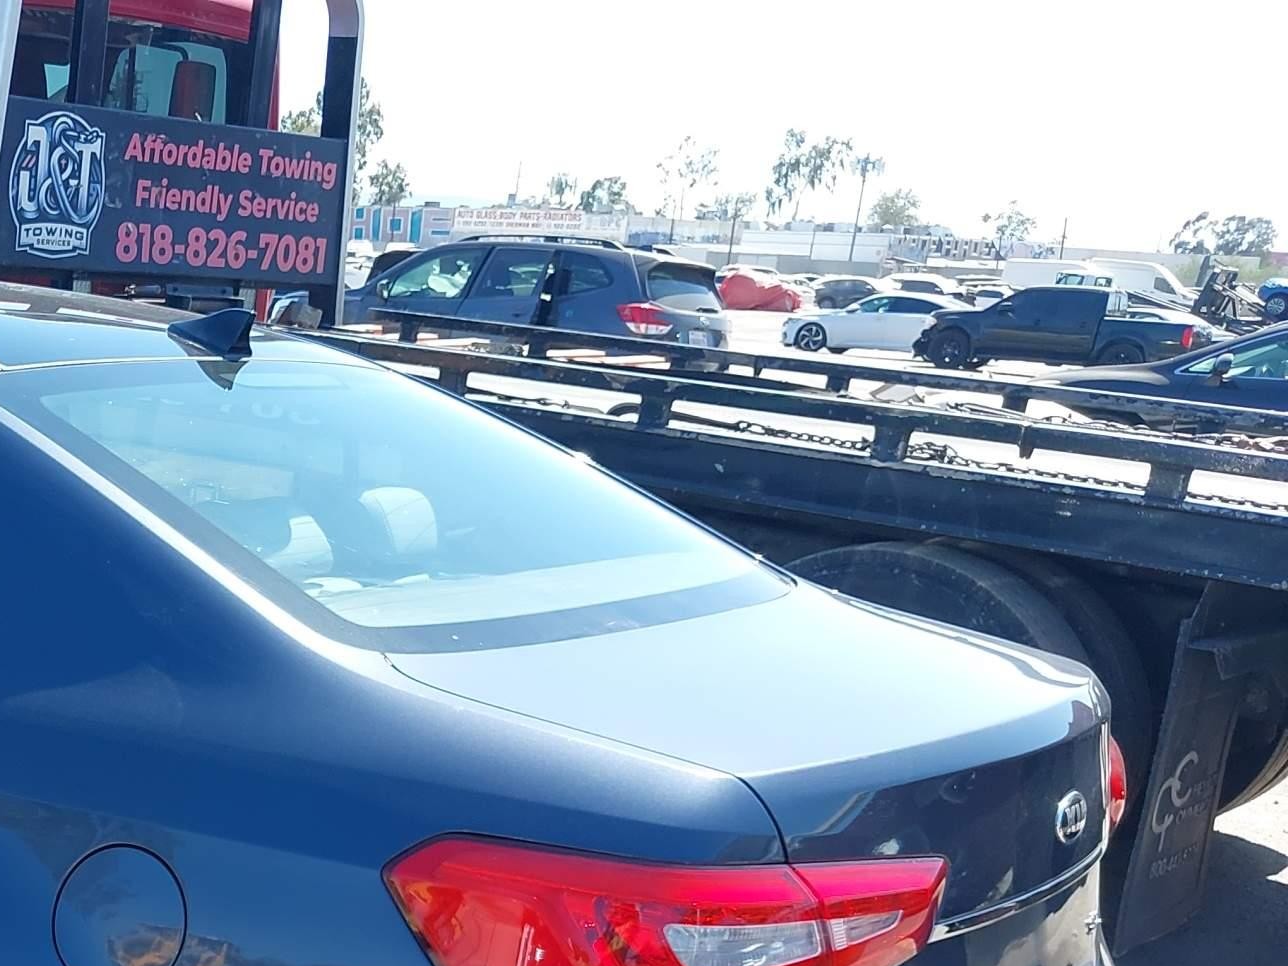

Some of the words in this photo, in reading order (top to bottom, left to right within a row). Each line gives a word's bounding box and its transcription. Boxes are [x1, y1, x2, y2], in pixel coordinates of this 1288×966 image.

[18, 116, 102, 224] J&T
[124, 132, 252, 174] Affordable
[259, 149, 338, 190] Towing
[135, 178, 233, 222] Friendly
[237, 190, 320, 222] Service
[23, 227, 85, 241] TOWING
[36, 238, 72, 247] SERVICES
[115, 222, 328, 274] 818-826-7081
